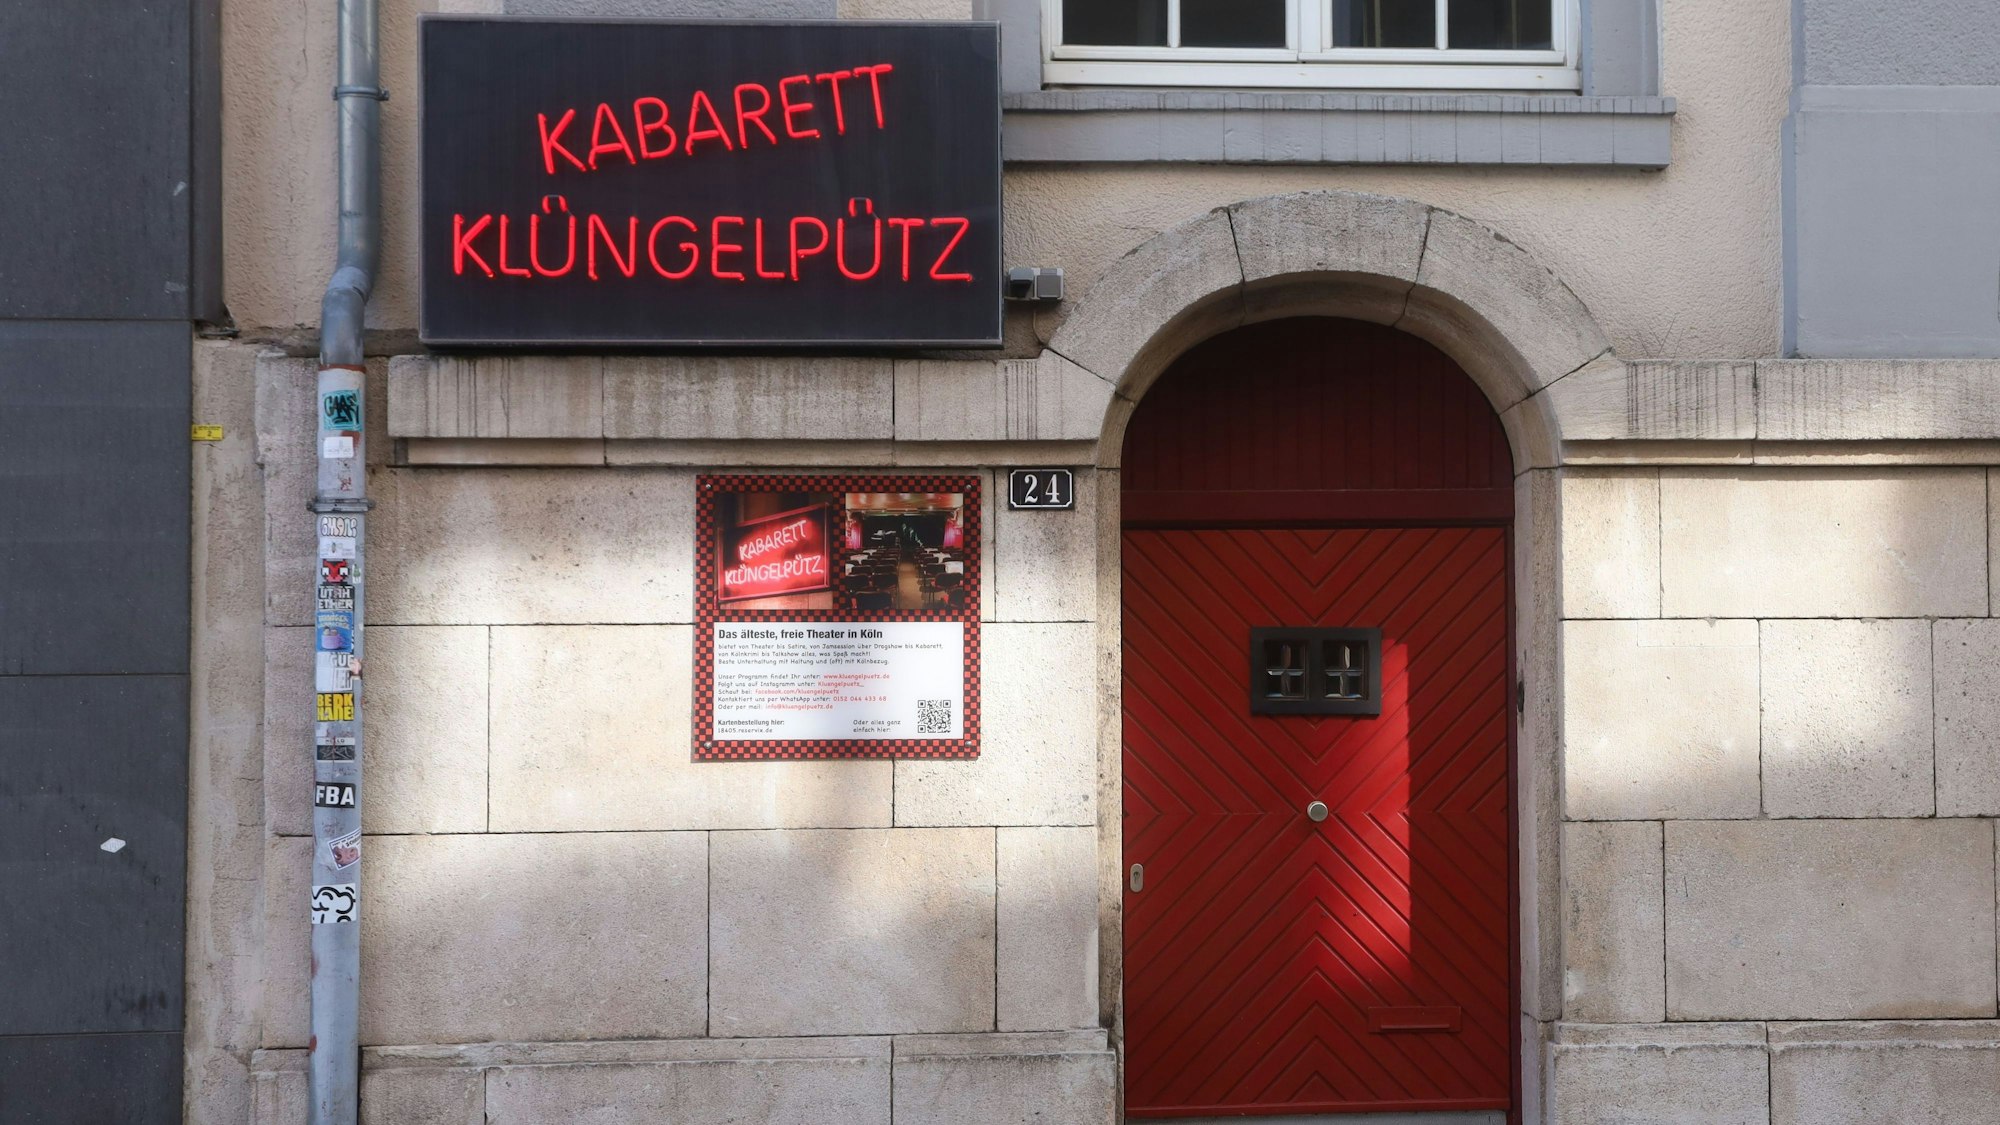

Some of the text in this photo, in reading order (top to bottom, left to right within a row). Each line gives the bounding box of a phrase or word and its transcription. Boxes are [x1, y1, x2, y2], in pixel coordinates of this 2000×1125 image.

[536, 62, 894, 176] KABARETT
[452, 194, 973, 282] KLÜNGELPÜTZ
[1024, 474, 1060, 504] 24
[738, 519, 807, 560] KABARETT
[725, 554, 824, 586] KLÜNGELPÜTZ
[718, 629, 882, 640] Das älteste, freie Theater in Köln
[316, 786, 354, 806] FBA
